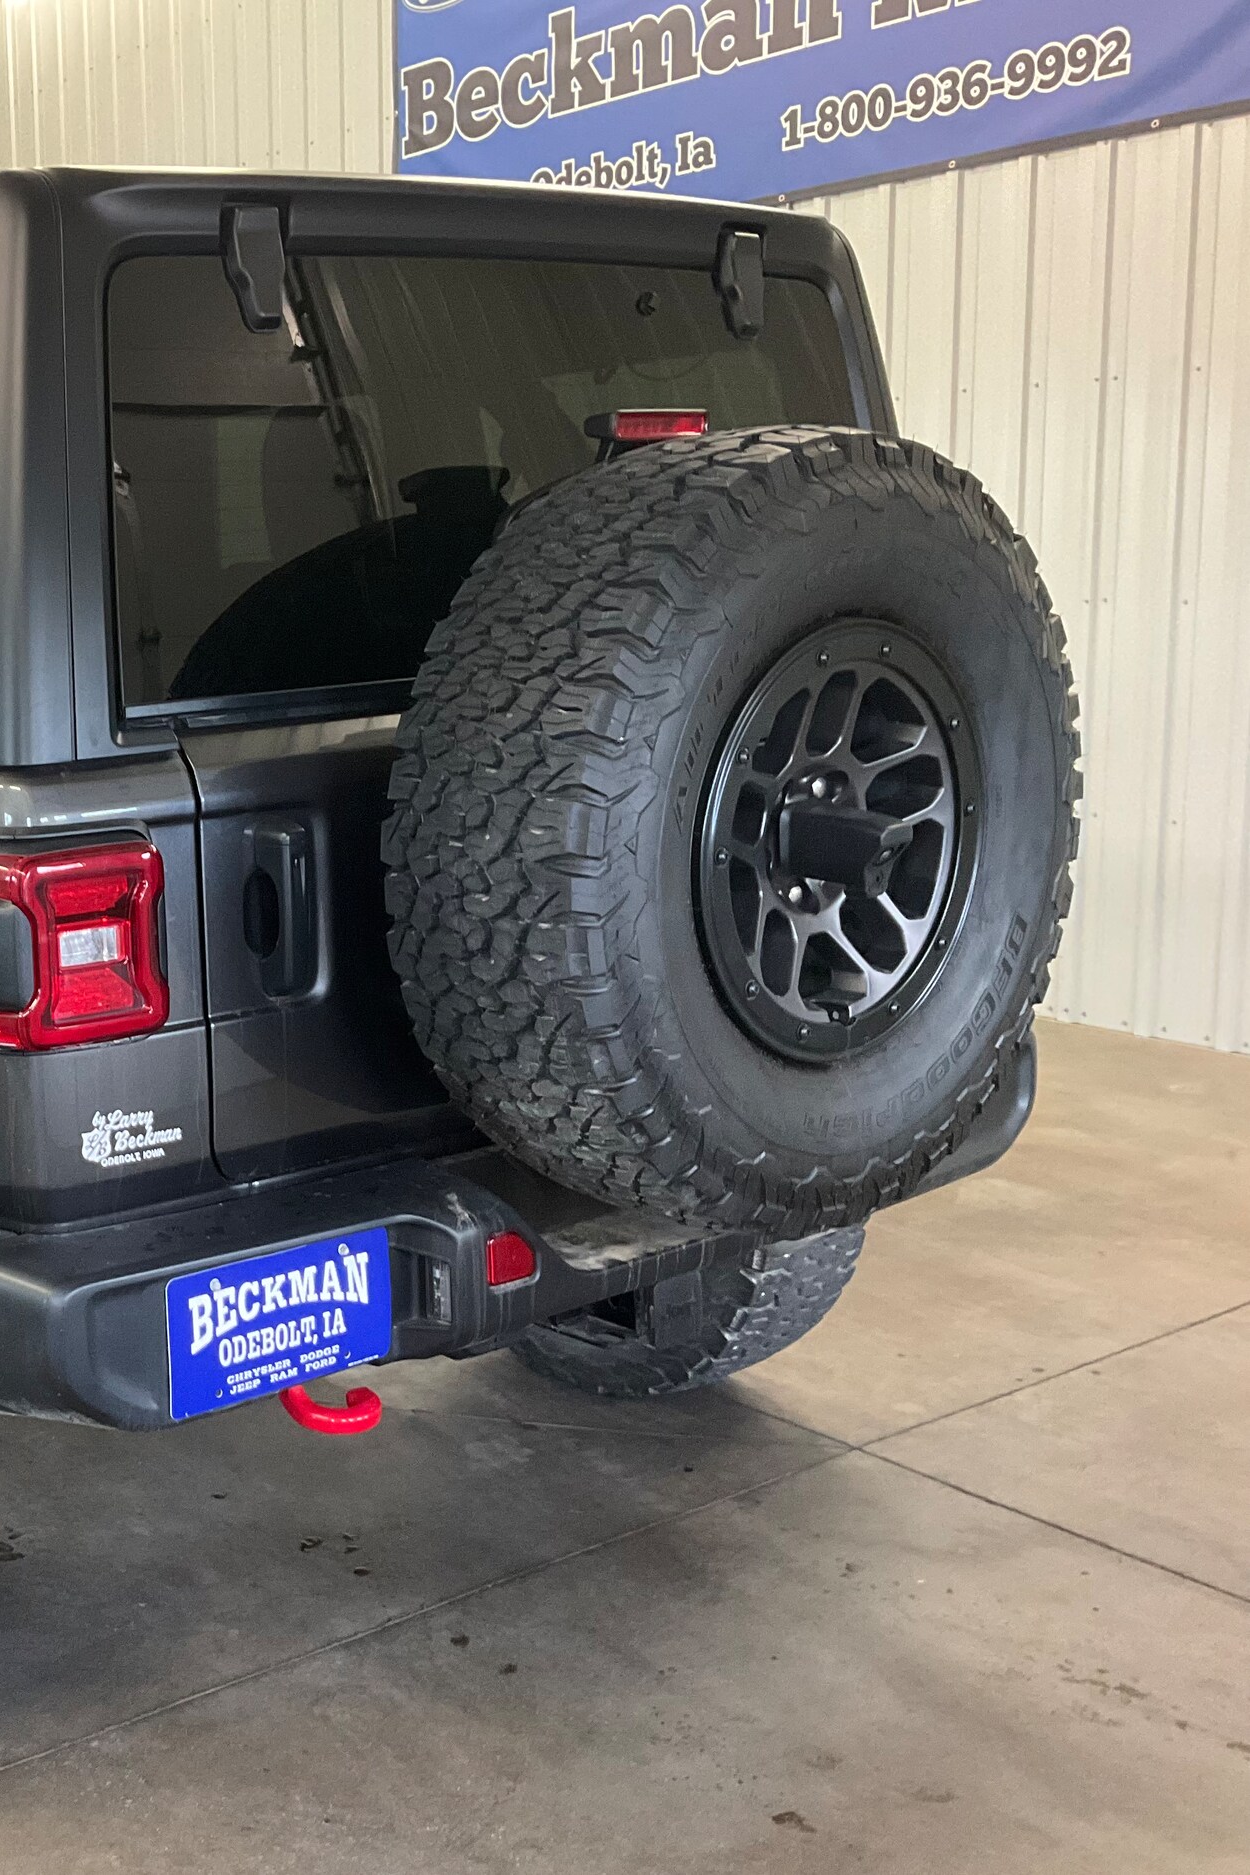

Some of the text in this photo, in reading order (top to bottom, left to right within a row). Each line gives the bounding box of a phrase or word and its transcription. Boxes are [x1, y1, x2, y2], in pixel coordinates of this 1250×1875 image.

[401, 0, 842, 159] Beckman
[780, 26, 1131, 151] 1-800-936-9992
[675, 131, 716, 176] Ia
[104, 1109, 154, 1130] Larry
[114, 1126, 182, 1151] Beckman
[100, 1147, 166, 1168] ODEBOLT IOWA
[188, 1251, 370, 1356] BECKMAN
[218, 1307, 348, 1368] ODEBOLT, IA
[226, 1358, 292, 1385] CHRYSLER
[300, 1344, 340, 1364] DODGE
[229, 1379, 262, 1396] JEEP
[269, 1367, 299, 1383] RAM
[305, 1356, 338, 1373] FORD
